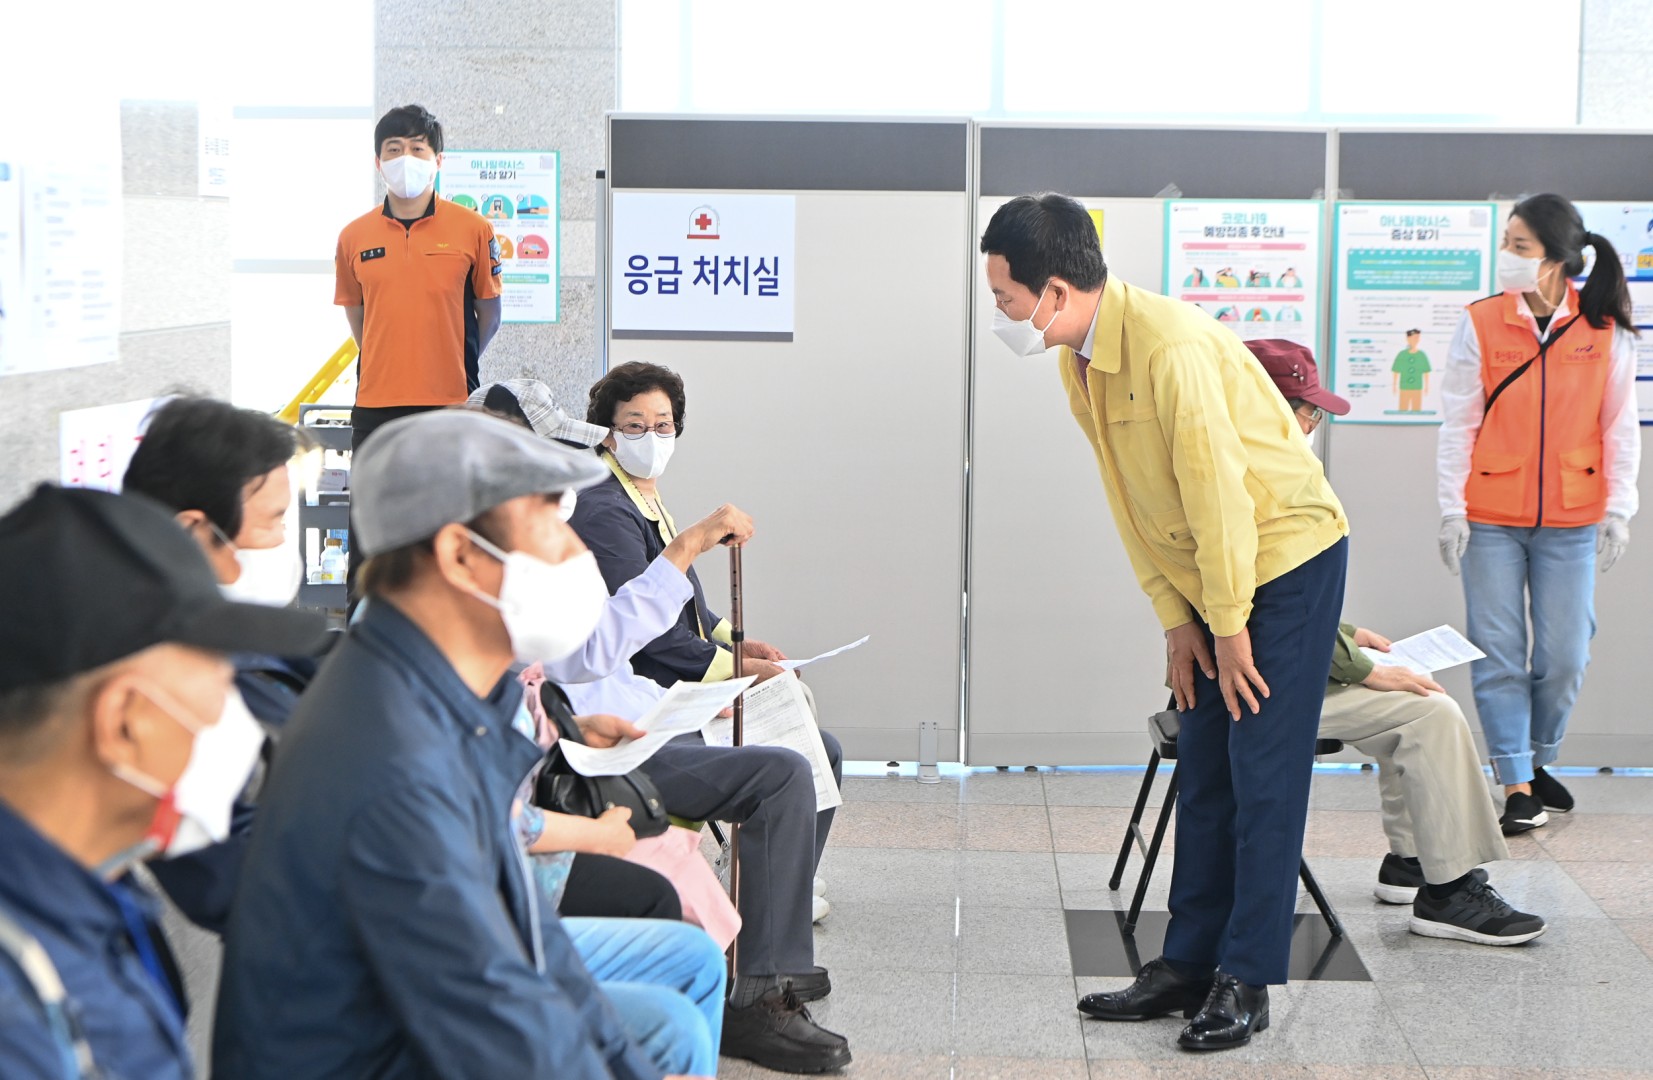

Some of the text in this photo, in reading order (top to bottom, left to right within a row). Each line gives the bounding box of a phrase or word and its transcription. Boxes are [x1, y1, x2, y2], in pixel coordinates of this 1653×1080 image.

[479, 171, 517, 180] 증상 알기
[1222, 212, 1268, 225] 코로나19
[1380, 215, 1450, 227] 아나필락시스
[1204, 226, 1248, 238] 예방접종
[1391, 229, 1439, 241] 증상 알기
[624, 254, 779, 297] 응급 처치실
